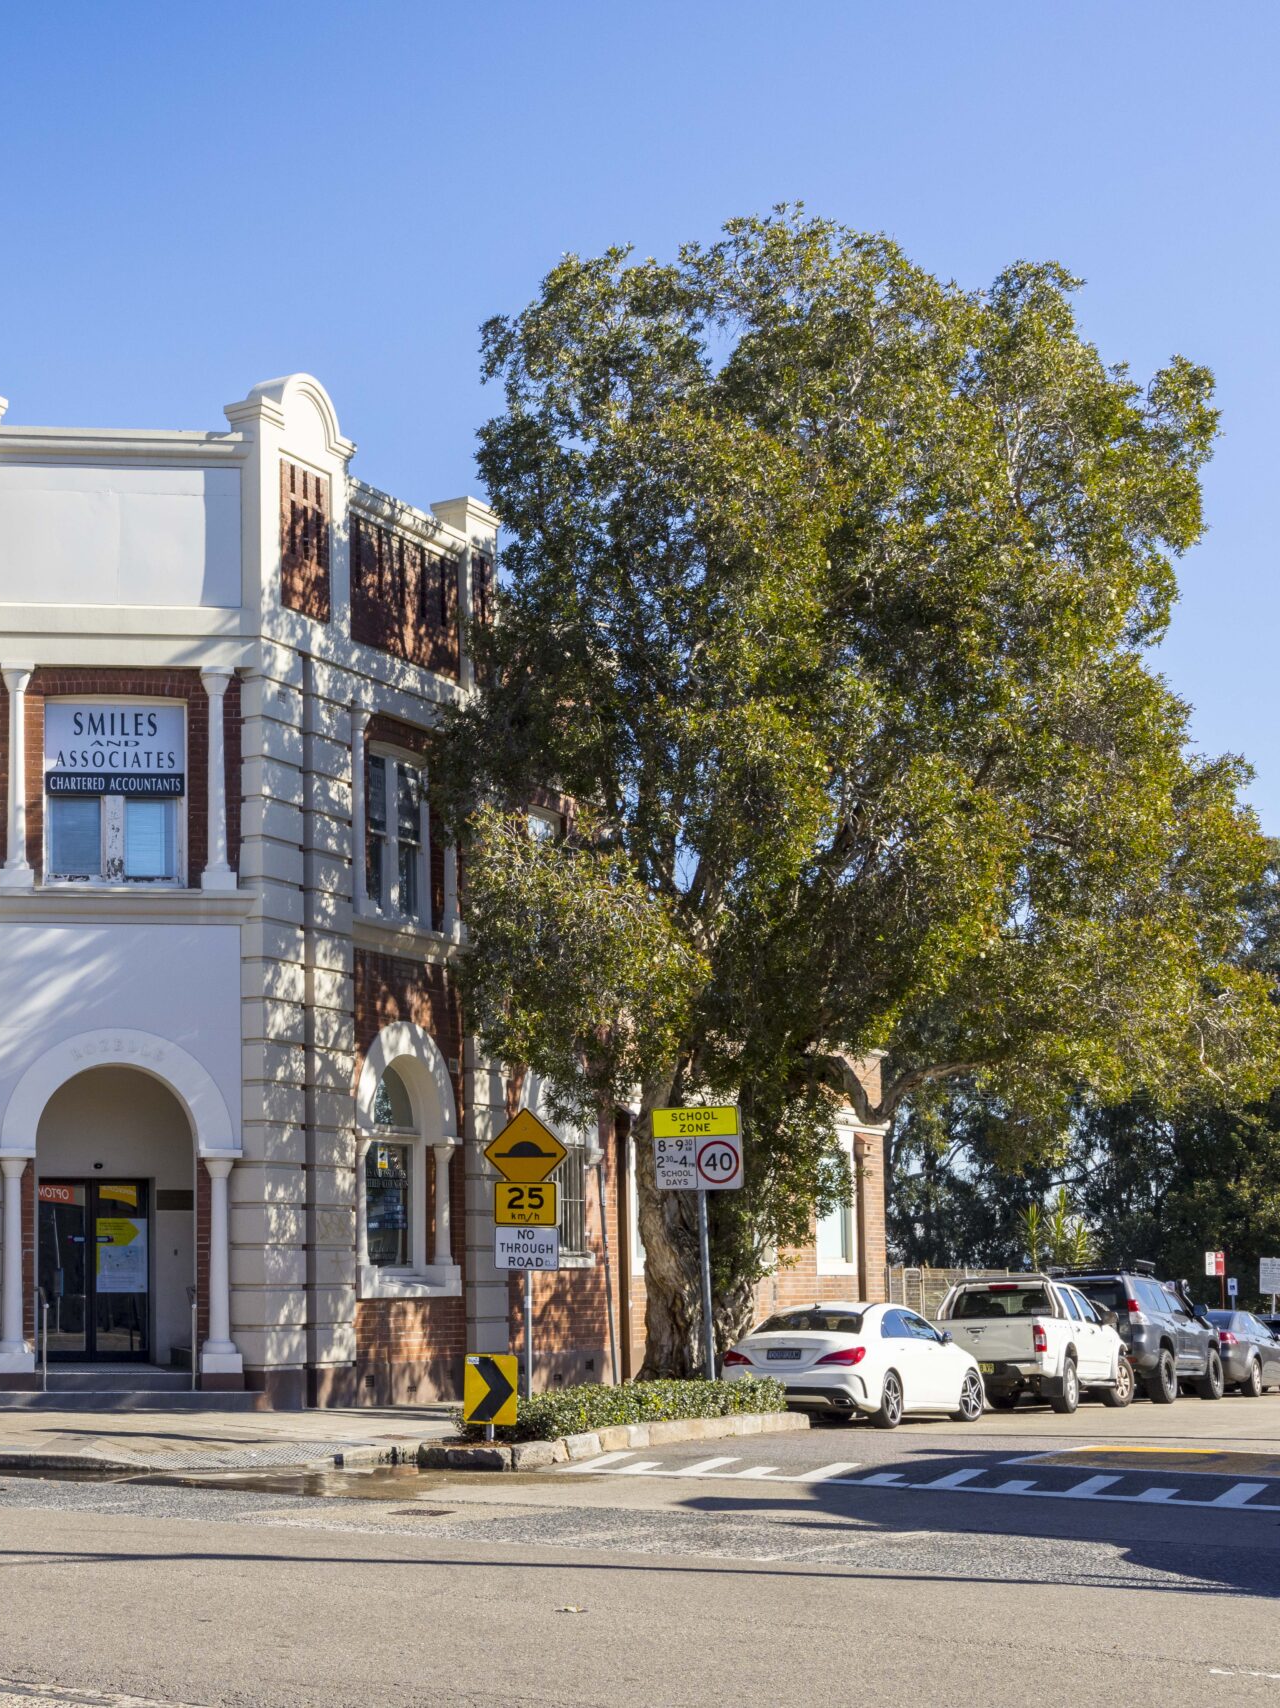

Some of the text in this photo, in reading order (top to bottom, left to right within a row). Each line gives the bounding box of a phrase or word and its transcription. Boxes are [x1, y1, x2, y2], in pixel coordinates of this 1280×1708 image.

[73, 712, 157, 736] SMILES
[56, 750, 175, 768] ASSOCIATES
[50, 776, 180, 792] CHARTERED ACCOUNTANTS
[671, 1111, 718, 1121] SCHOOL
[679, 1123, 711, 1133] ZONE
[704, 1153, 732, 1171] 40
[507, 1187, 544, 1209] 25
[511, 1212, 540, 1222] km/h
[517, 1230, 535, 1240] NO
[499, 1242, 554, 1254] THROUGH
[508, 1257, 543, 1268] ROAD
